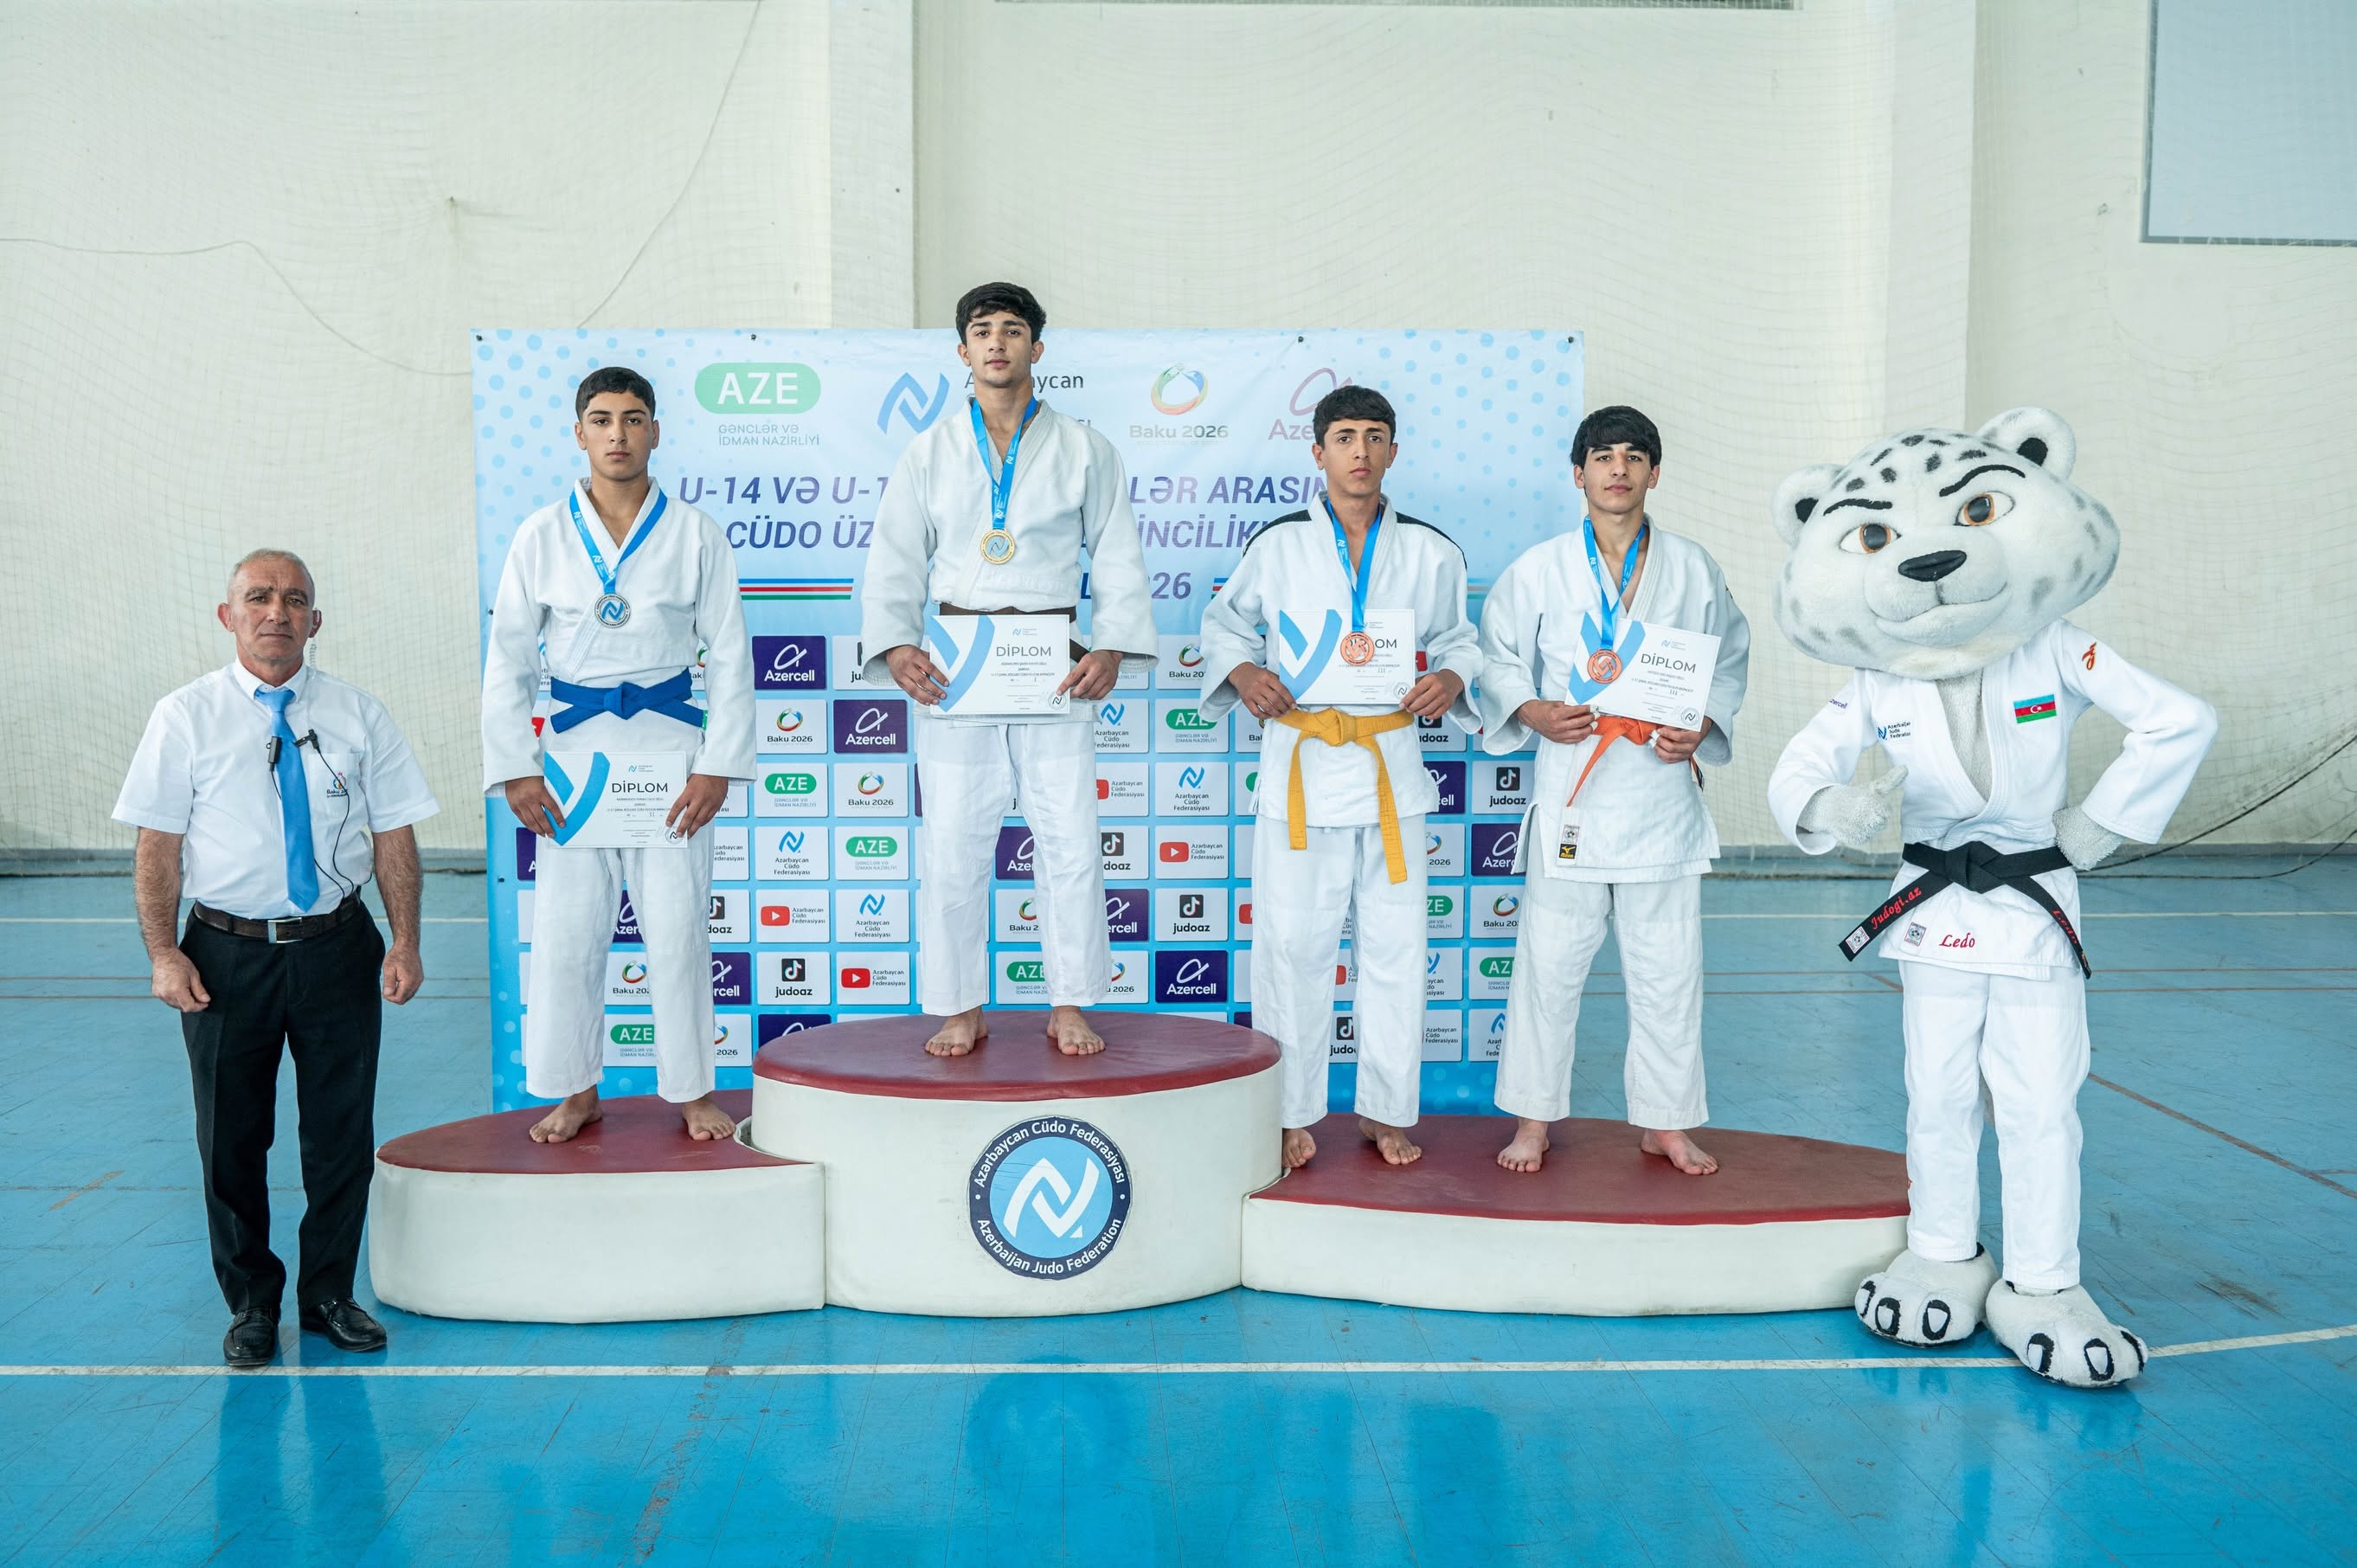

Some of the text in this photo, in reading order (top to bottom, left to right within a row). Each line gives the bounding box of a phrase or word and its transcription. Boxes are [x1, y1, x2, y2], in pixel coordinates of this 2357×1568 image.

[717, 372, 798, 405] AZE
[719, 424, 799, 434] GƏNCLƏR VƏ
[1129, 425, 1229, 438] Baku 2026
[719, 434, 819, 446] İDMAN NAZİRLİYİ
[679, 476, 1328, 504] U-14 VƏ U-1 LƏR ARASIN
[726, 515, 822, 549] CÜDO
[832, 515, 874, 549] ÜZ
[1149, 572, 1191, 600] 26
[996, 644, 1051, 657] DİPLOM
[1641, 652, 1696, 673] DİPLOM
[764, 670, 815, 681] Azercell
[845, 733, 896, 745] Azercell
[1419, 733, 1448, 742] doaz
[612, 781, 668, 794] DİPLOM
[774, 777, 807, 791] AZE
[1489, 795, 1526, 807] judoaz
[855, 839, 889, 854] AZE
[1103, 861, 1131, 871] doaz
[1427, 899, 1444, 912] ZE
[1871, 887, 1922, 930] Judogi.az
[707, 924, 732, 934] doaz
[1172, 922, 1210, 935] judoaz
[1938, 932, 1975, 948] Ledo
[1488, 961, 1511, 974] AZ
[713, 986, 740, 997] rcell
[775, 986, 812, 998] judoaz
[1166, 983, 1217, 994] Azercell
[620, 1027, 652, 1041] AZE
[1329, 1044, 1356, 1056] judo
[974, 1121, 1125, 1188] Azərbaycan Cüdo Federasiyası
[978, 1218, 1121, 1274] Azerbaijan Judo Federation
